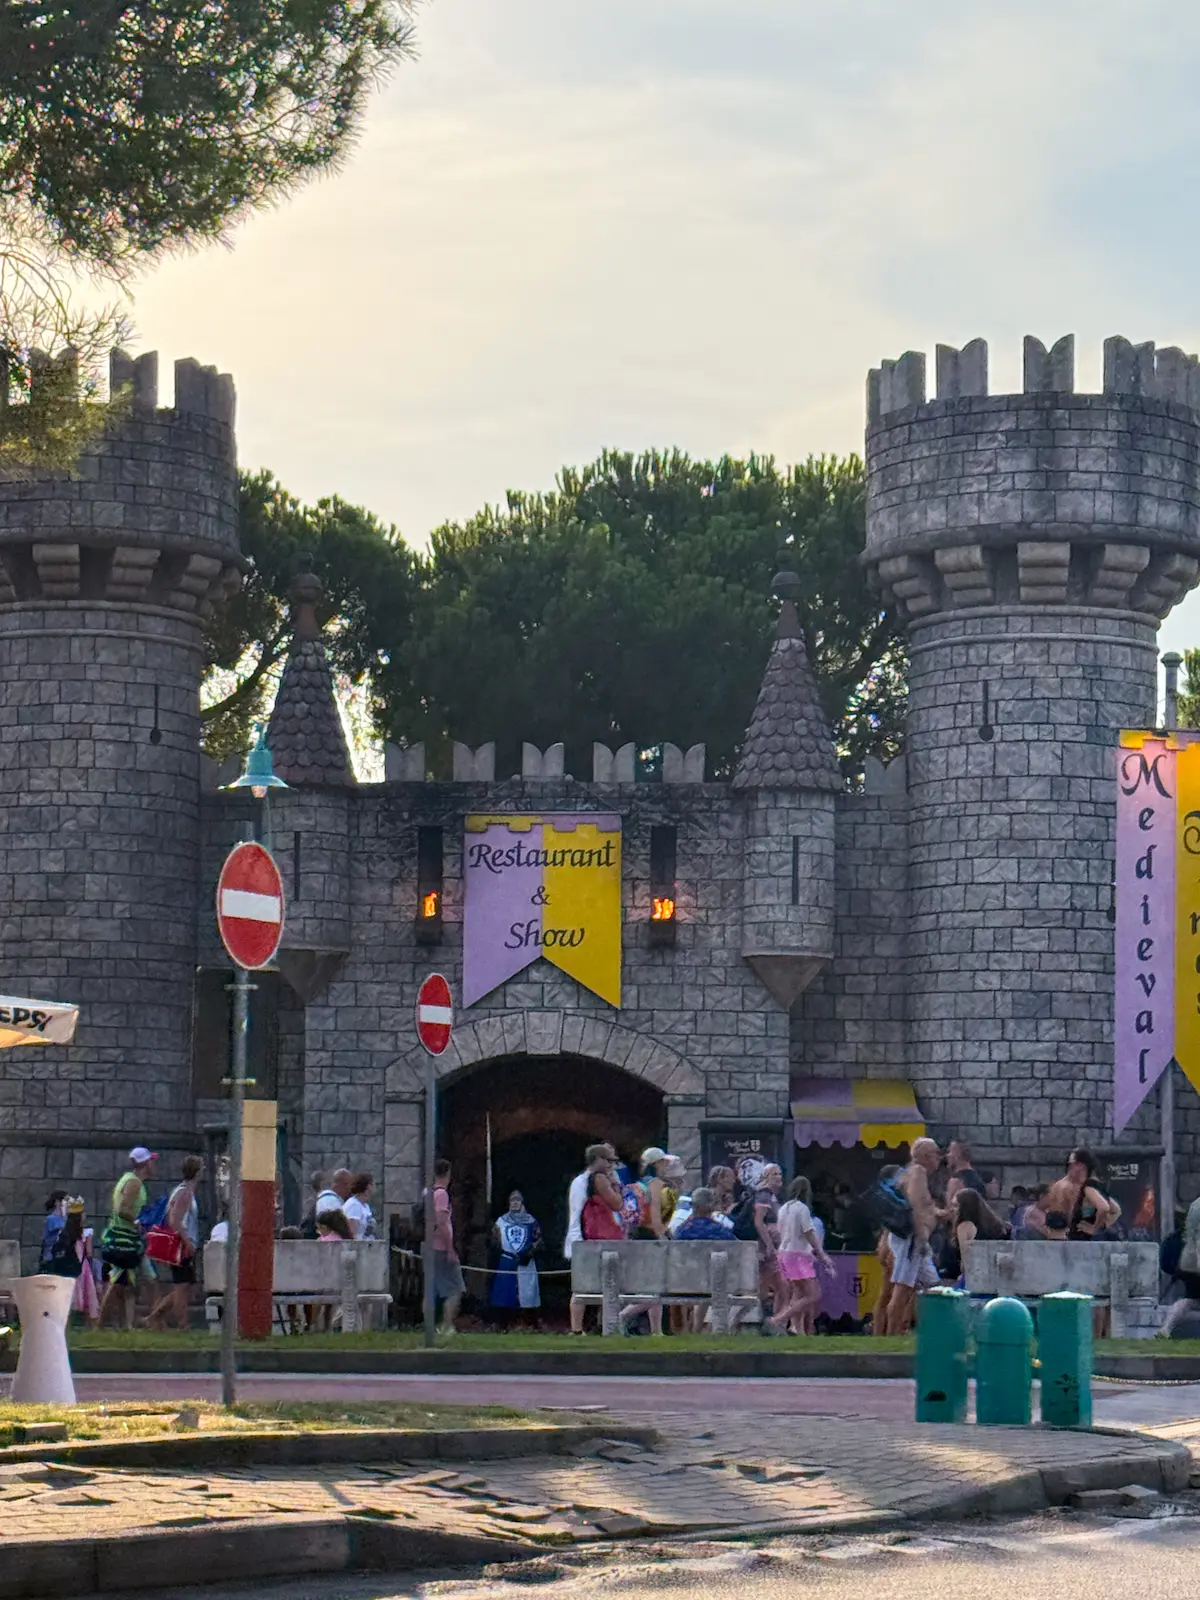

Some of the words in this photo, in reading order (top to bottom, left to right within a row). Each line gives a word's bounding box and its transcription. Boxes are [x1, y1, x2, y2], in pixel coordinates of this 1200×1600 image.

[469, 840, 616, 874] Restaurant
[530, 885, 552, 906] &
[504, 919, 585, 949] Show
[1121, 753, 1173, 1084] Medieval
